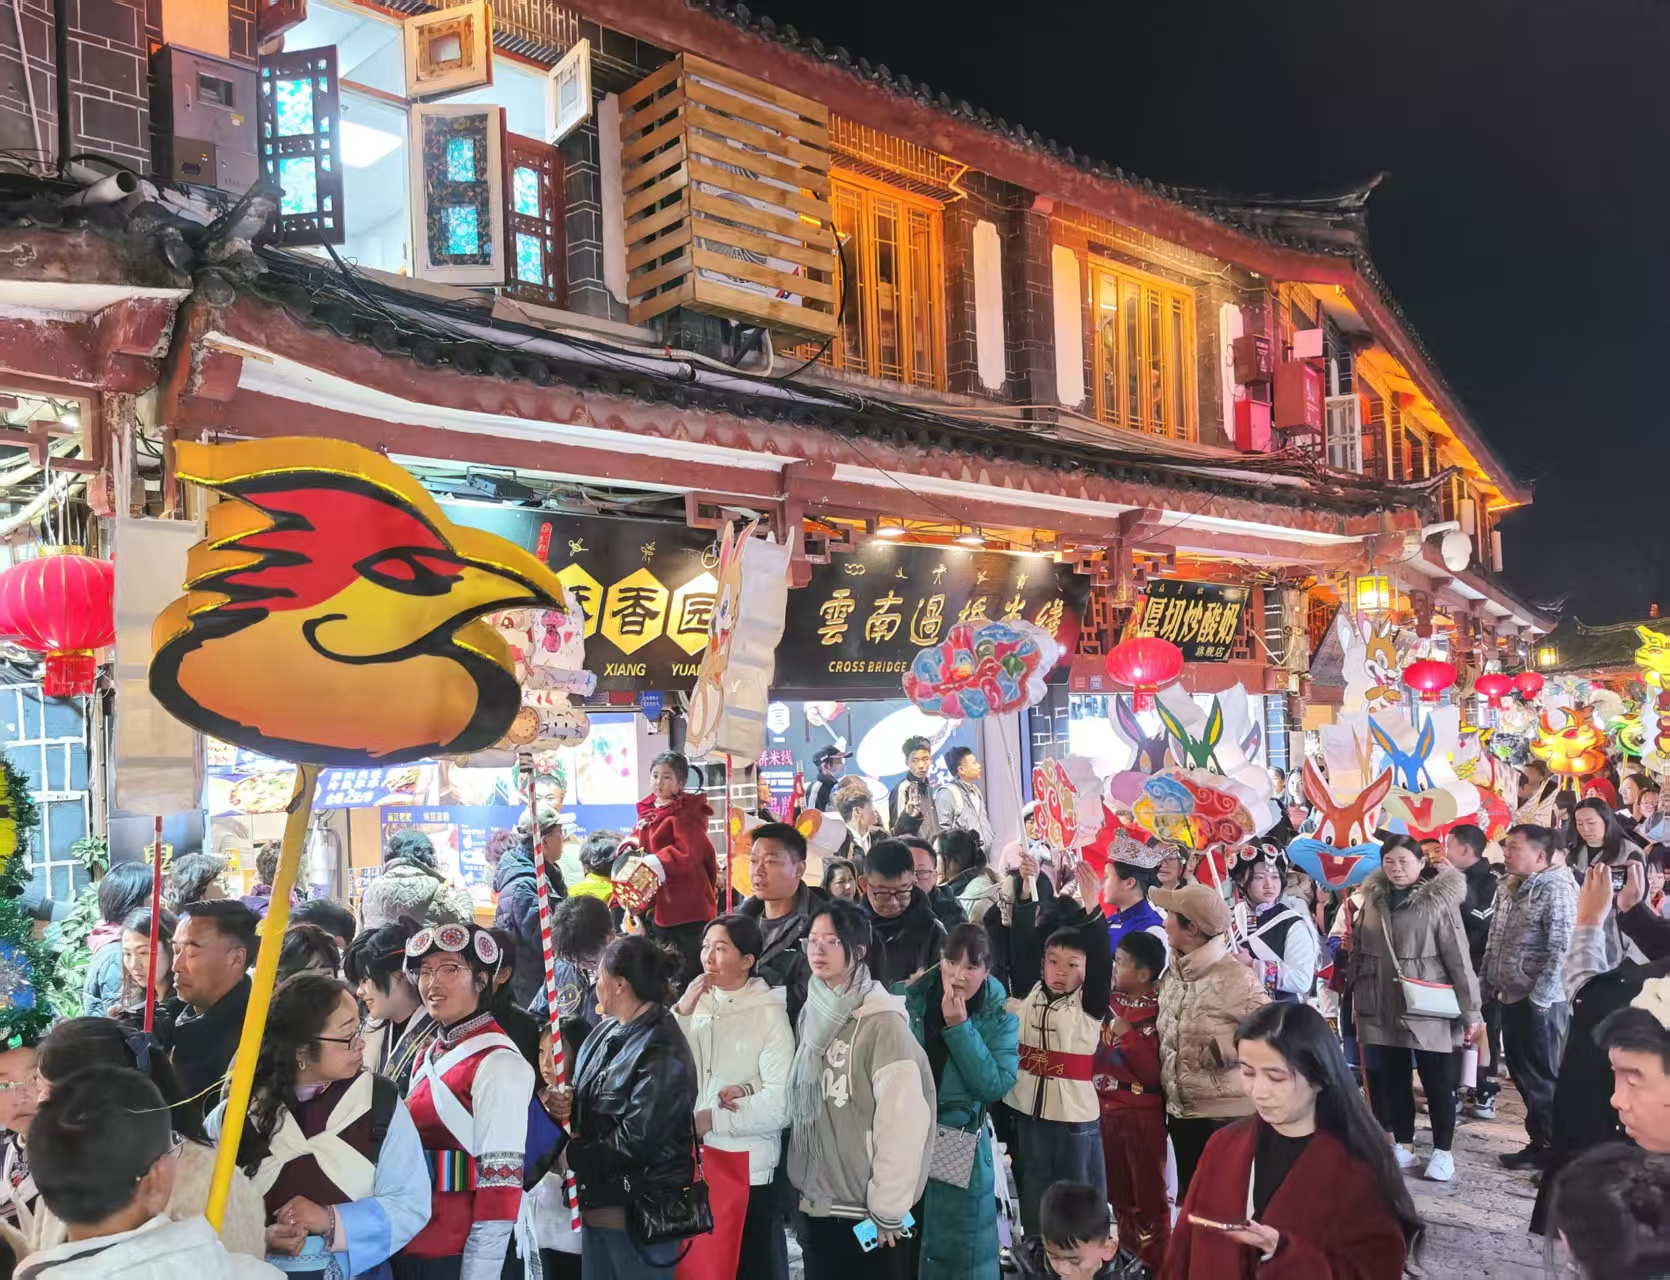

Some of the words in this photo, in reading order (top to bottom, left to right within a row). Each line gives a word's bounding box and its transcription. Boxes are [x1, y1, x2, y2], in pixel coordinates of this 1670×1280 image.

[1141, 596, 1240, 645] 厚切炒酸奶
[1195, 645, 1225, 658] 旗舰店
[603, 663, 647, 676] XIANG
[828, 660, 865, 673] CROSS
[867, 660, 907, 673] BRIDGE
